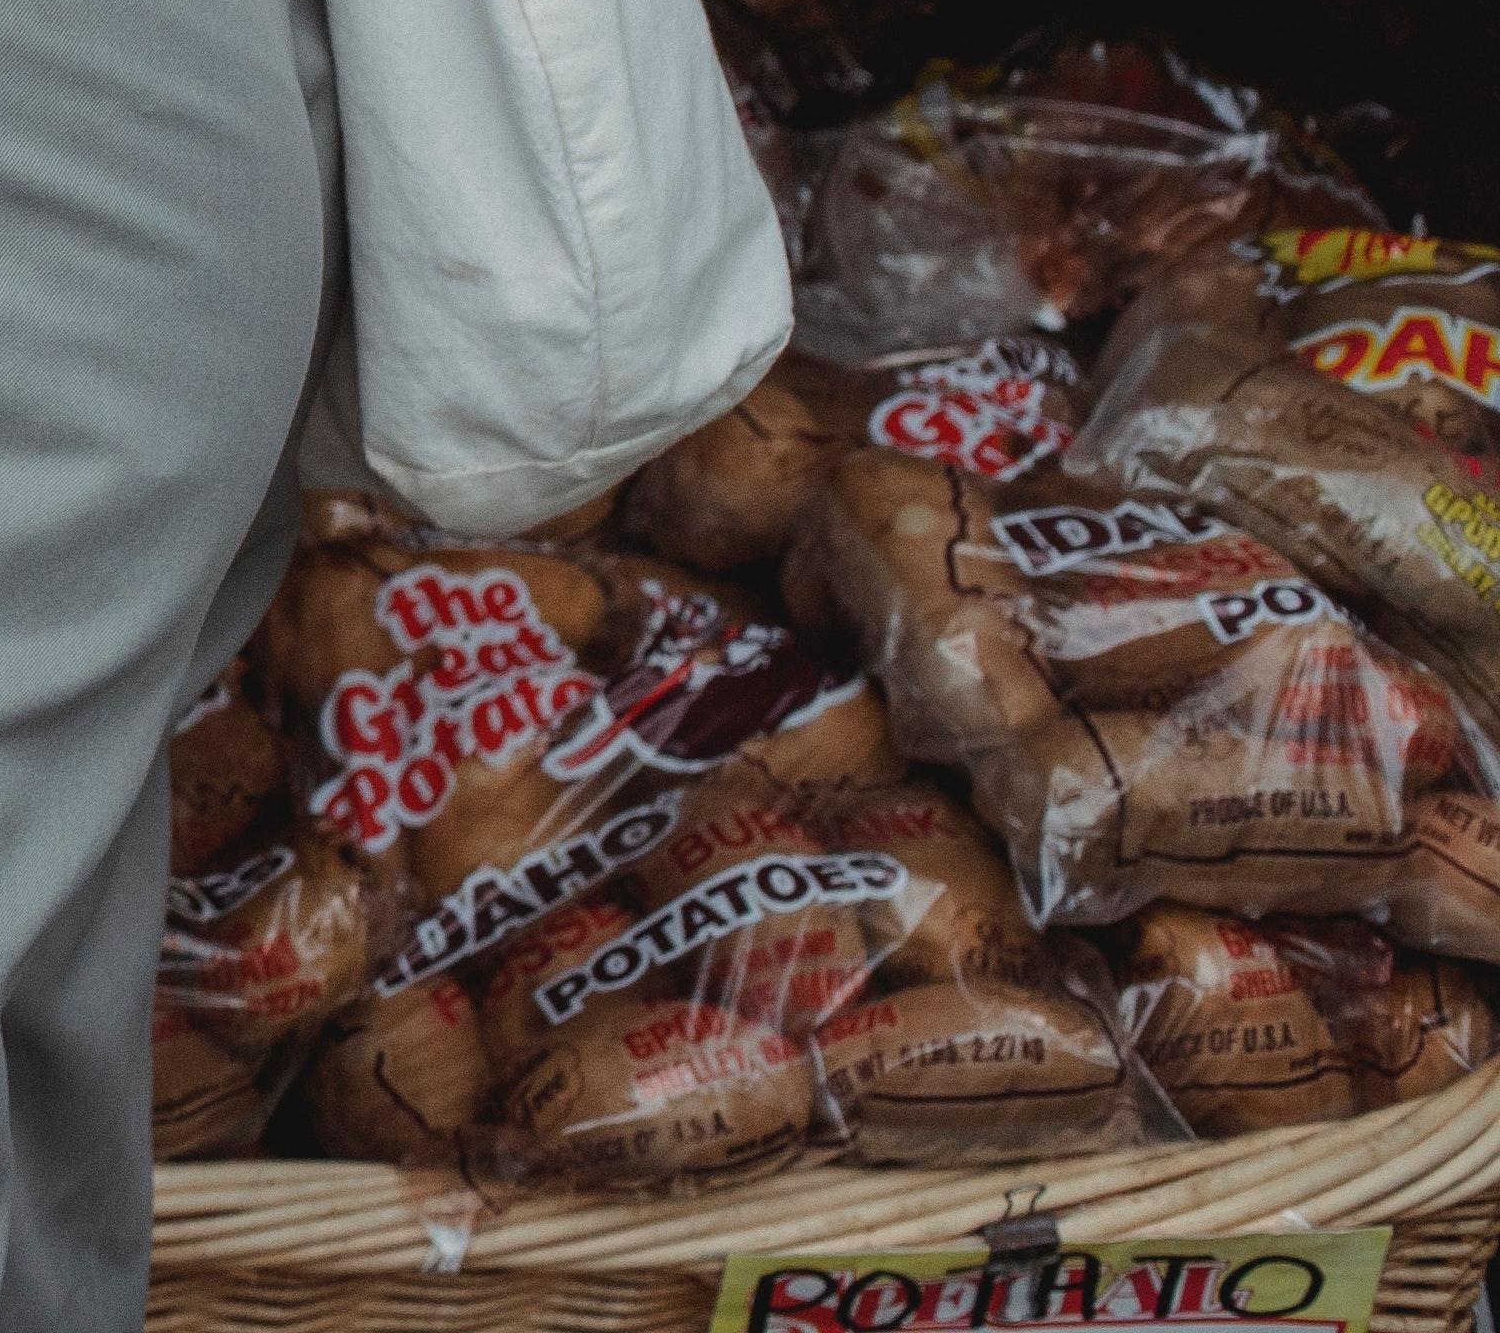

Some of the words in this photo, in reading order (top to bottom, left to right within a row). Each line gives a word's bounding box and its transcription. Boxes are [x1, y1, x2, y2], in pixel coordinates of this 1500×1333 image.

[385, 571, 526, 644] the
[322, 671, 604, 844] Potato
[333, 626, 562, 764] Great
[541, 855, 904, 1018] POTATOES
